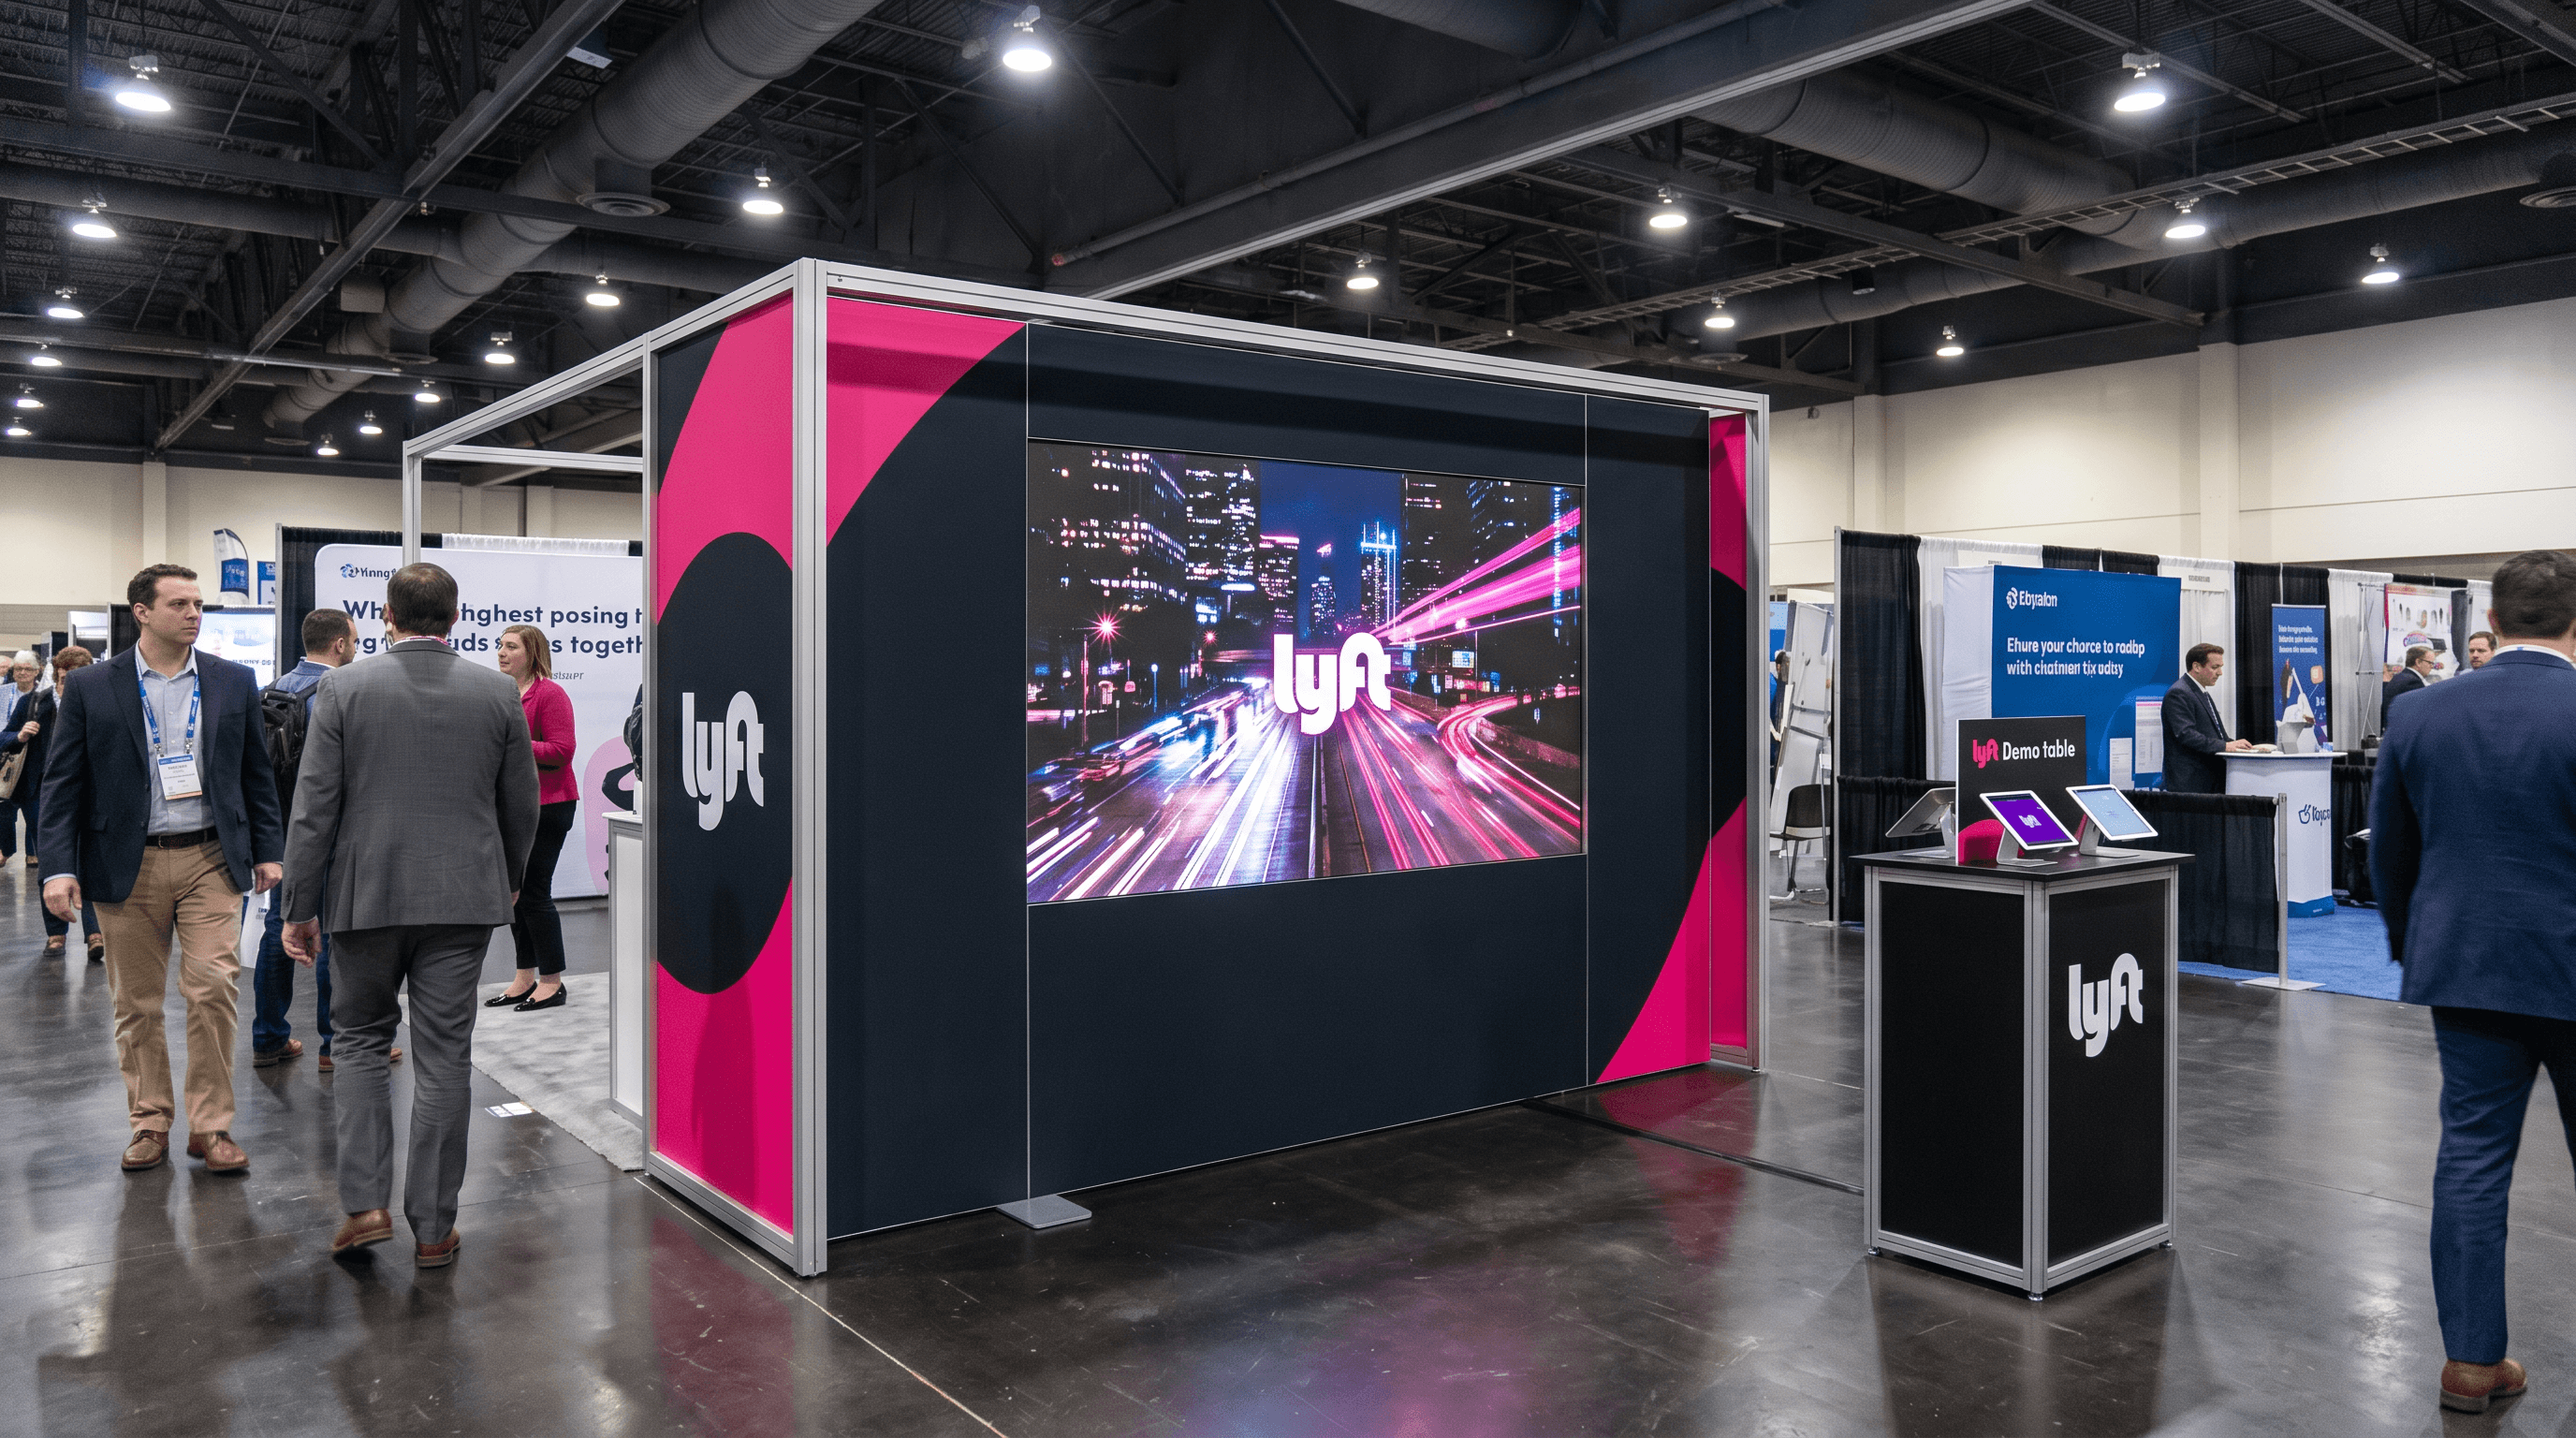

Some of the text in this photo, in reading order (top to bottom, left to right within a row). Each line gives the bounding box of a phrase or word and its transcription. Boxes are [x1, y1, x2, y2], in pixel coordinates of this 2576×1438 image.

[550, 606, 628, 629] posing
[2041, 640, 2065, 657] your
[2102, 639, 2114, 653] to
[2006, 658, 2032, 675] with
[1274, 632, 1392, 735] lyft
[681, 690, 764, 831] lyft
[1972, 738, 2075, 769] lyft Demo table
[2069, 952, 2144, 1058] lyft
